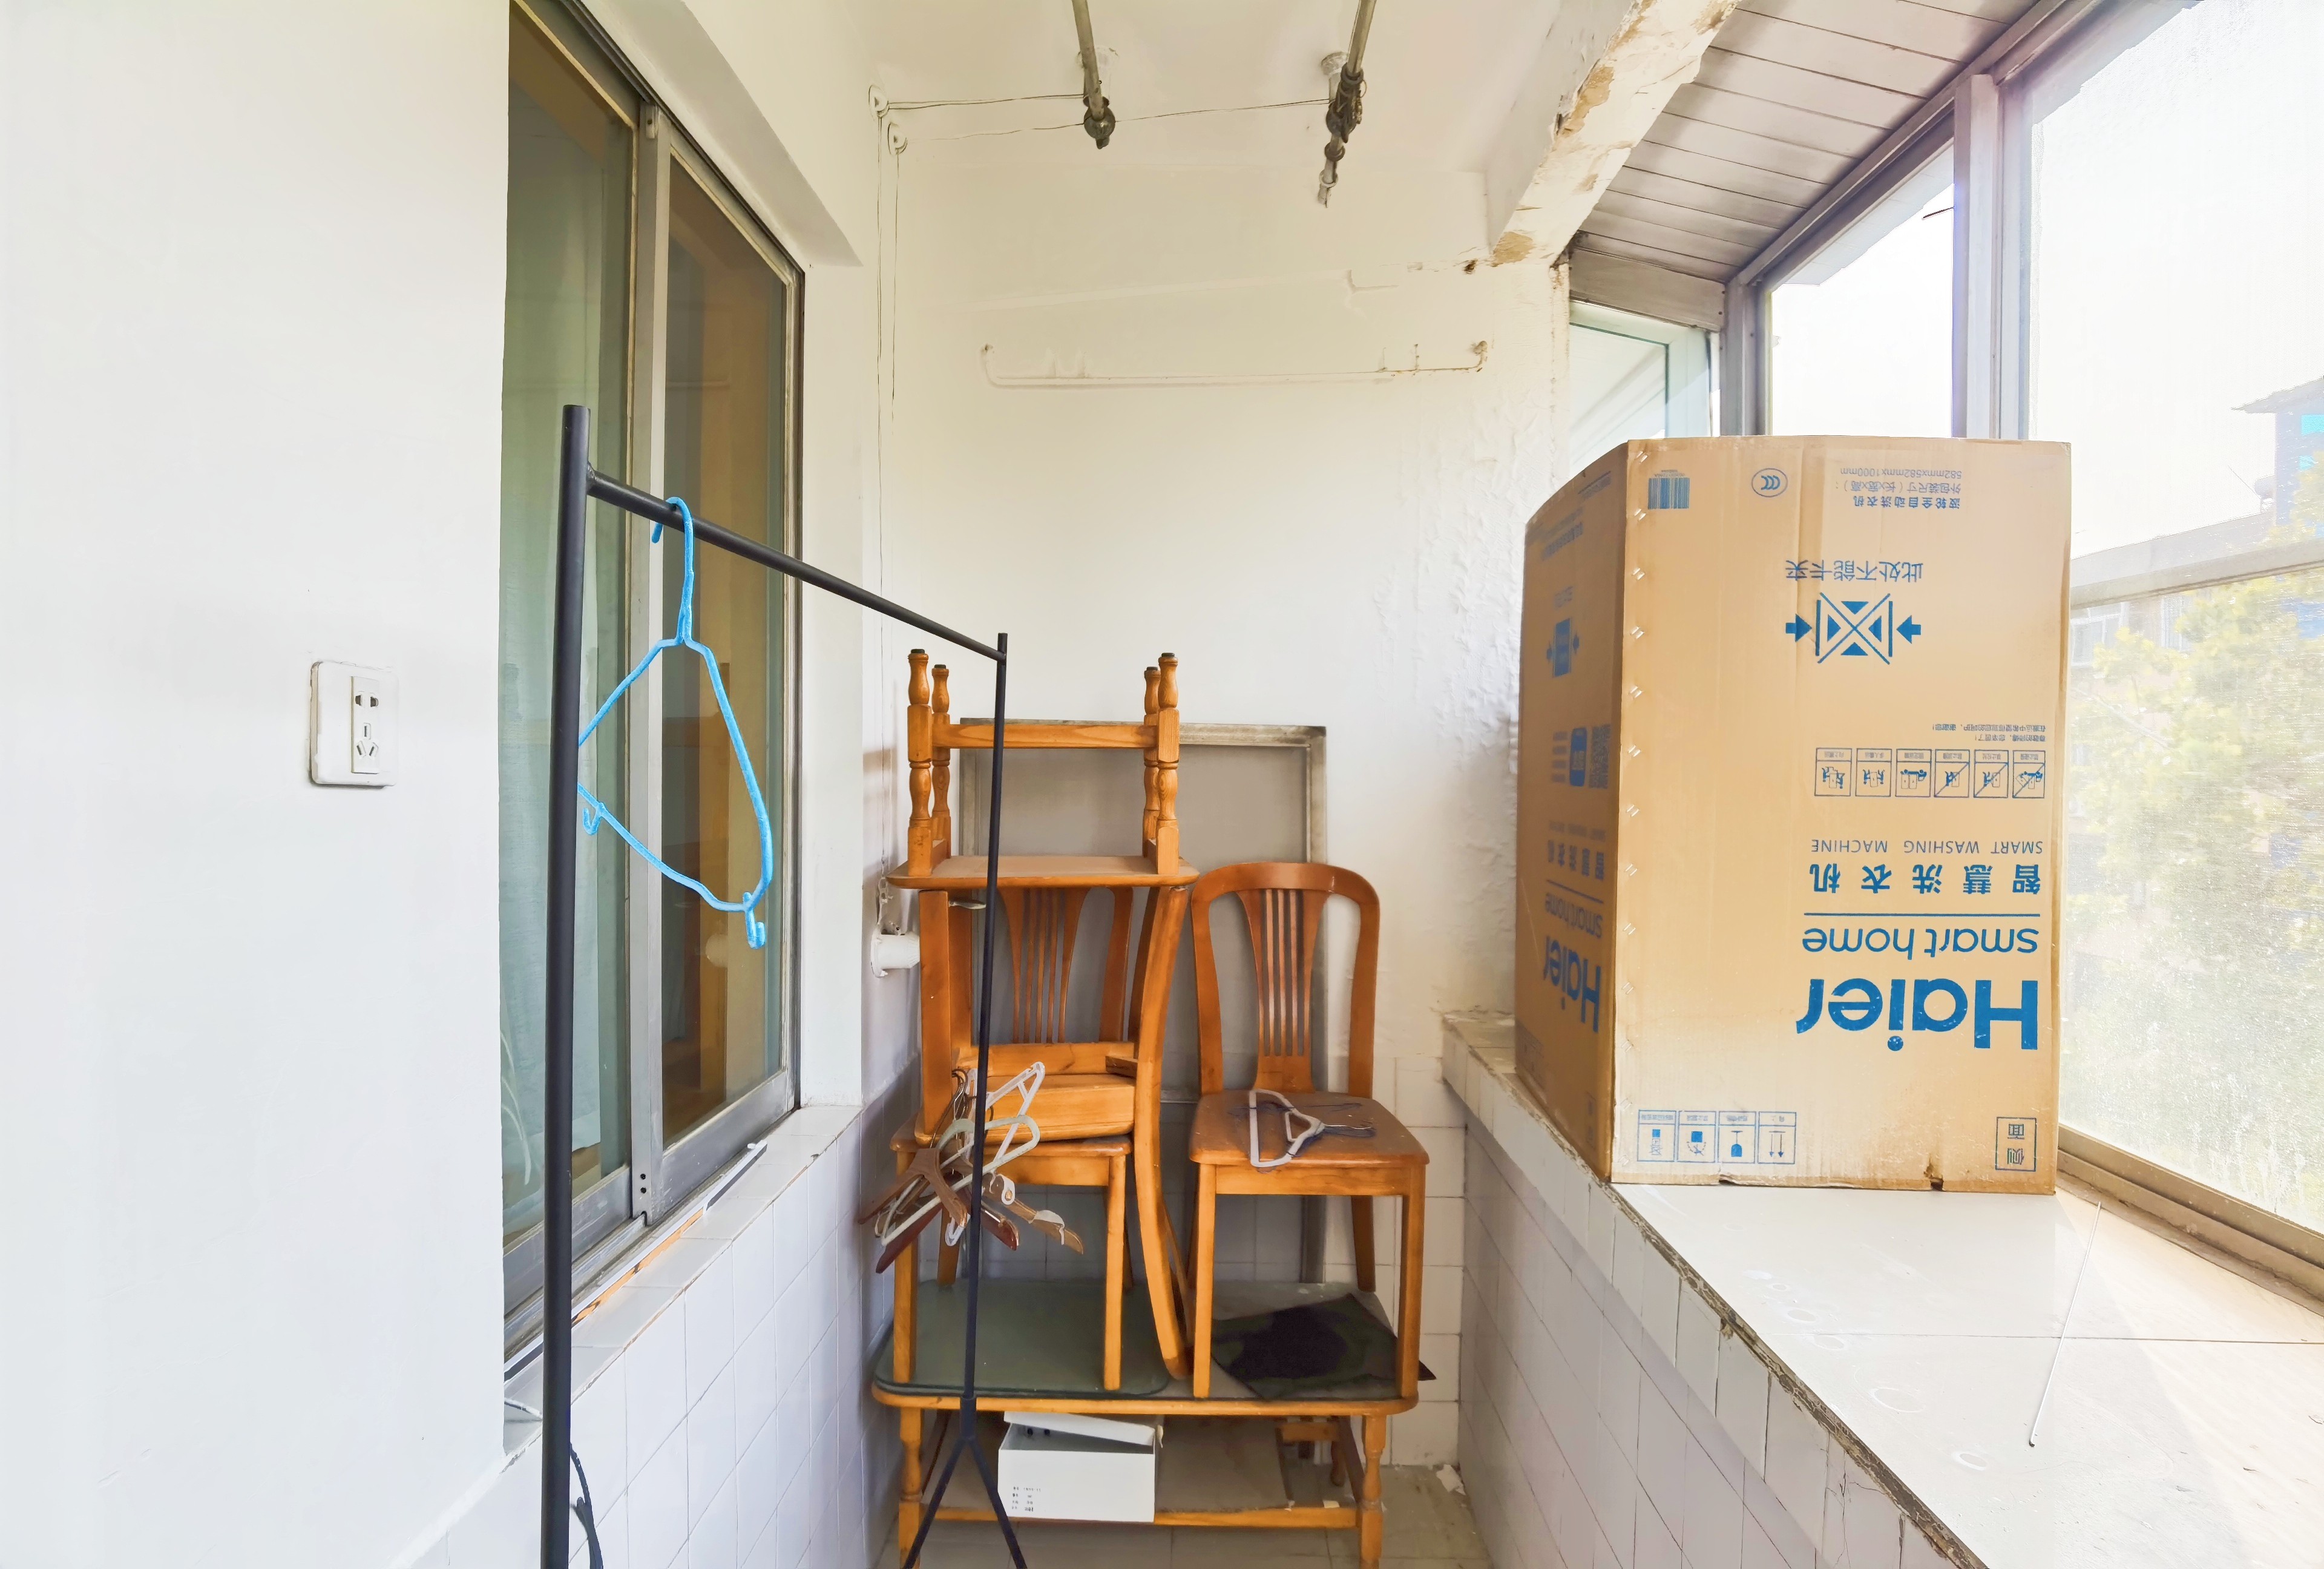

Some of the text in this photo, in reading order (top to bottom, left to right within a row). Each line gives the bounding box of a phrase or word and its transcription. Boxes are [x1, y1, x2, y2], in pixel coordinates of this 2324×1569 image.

[1853, 495, 1960, 509] 波轮全自动洗衣机
[1785, 559, 1923, 583] 此处不能卡夹
[1811, 839, 2043, 854] SMART WASHING MACHINE
[1809, 863, 2041, 895] 智慧洗衣机
[1802, 928, 2039, 960] smart home
[1543, 936, 1601, 1033] Haier
[1796, 978, 2038, 1051] Haier
[2006, 1123, 2025, 1166] 侧面
